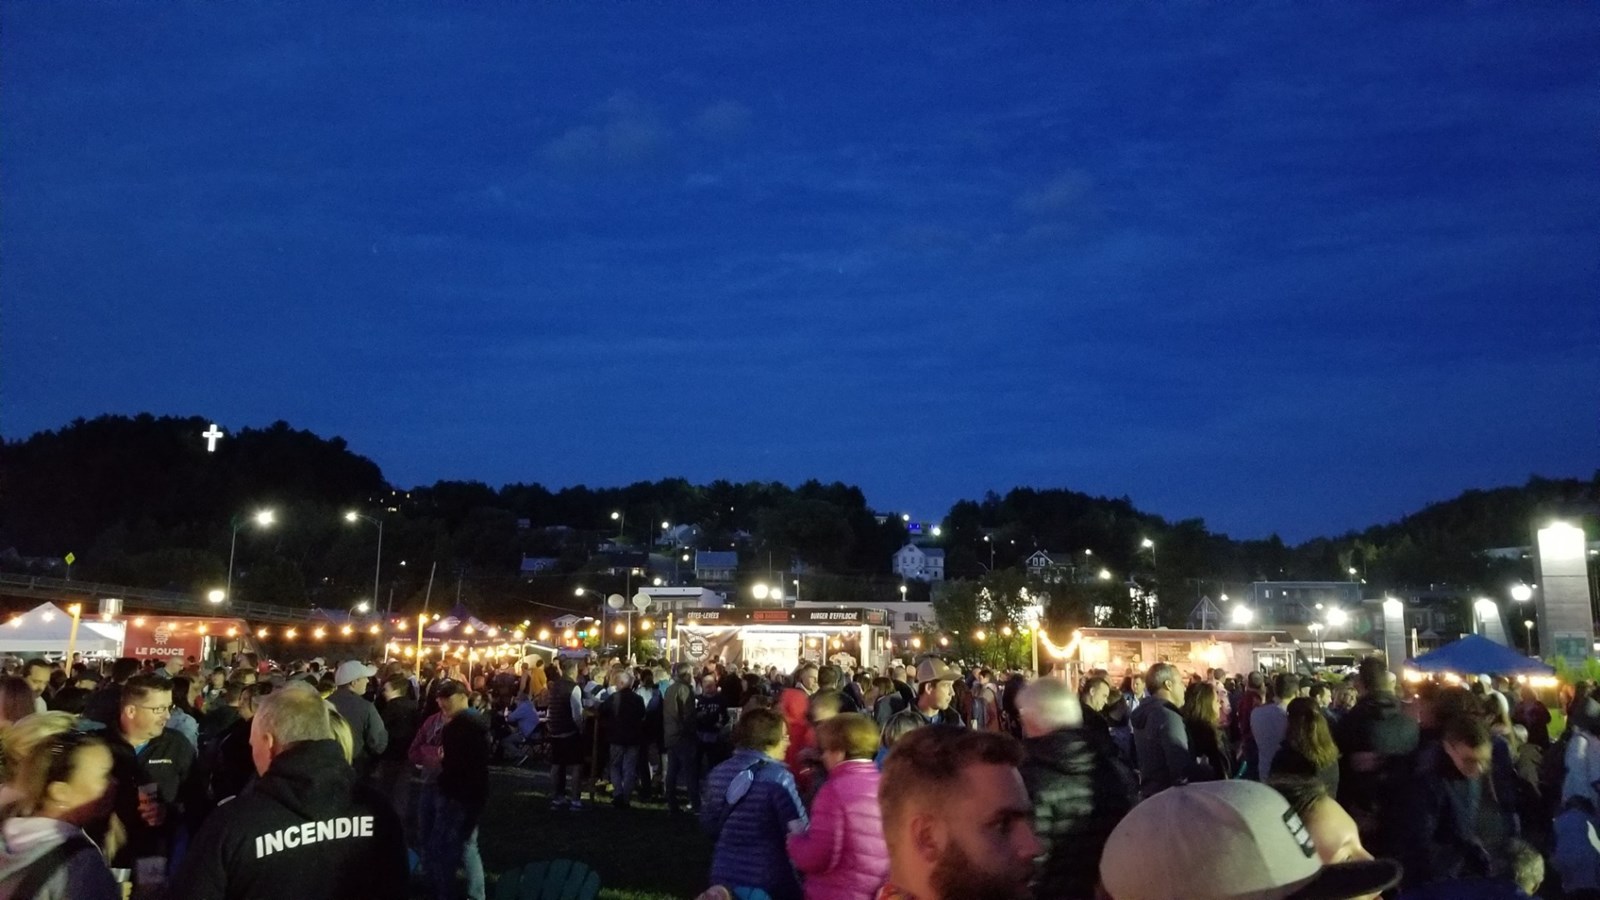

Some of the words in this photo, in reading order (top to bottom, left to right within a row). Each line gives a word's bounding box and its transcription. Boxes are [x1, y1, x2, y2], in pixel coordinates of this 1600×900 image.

[810, 612, 829, 620] BURGER
[135, 647, 148, 655] LE
[149, 647, 185, 656] POUCE
[255, 816, 374, 858] INCENDIE
